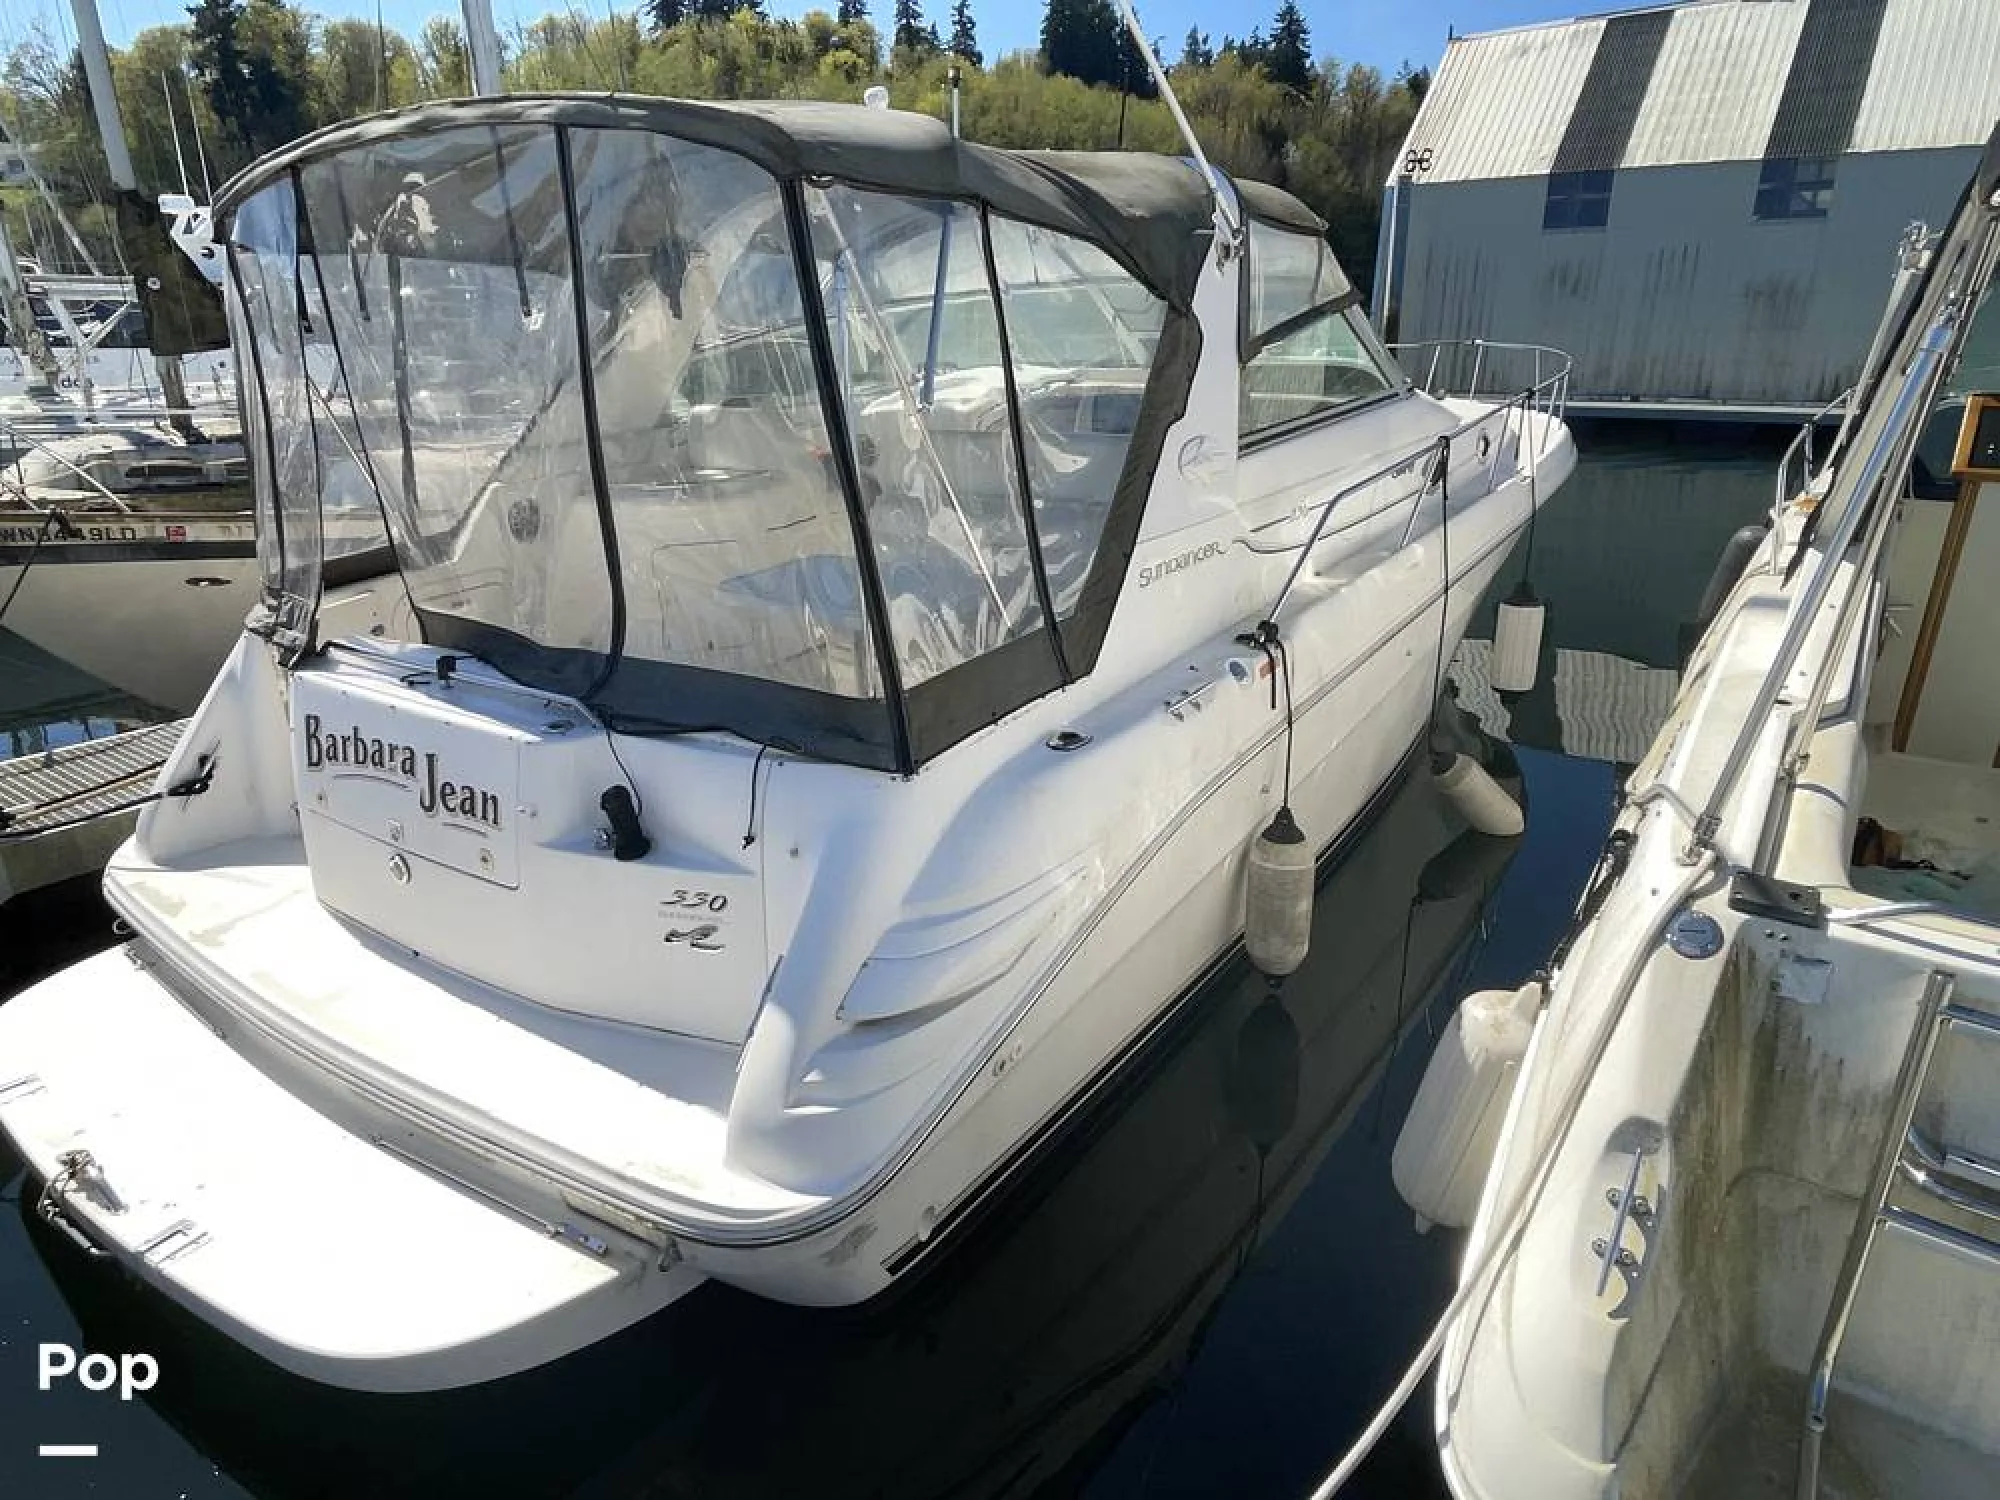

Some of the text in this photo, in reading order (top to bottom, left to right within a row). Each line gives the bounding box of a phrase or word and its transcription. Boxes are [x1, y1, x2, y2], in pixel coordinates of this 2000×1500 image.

[304, 714, 416, 778] Barbara
[419, 752, 499, 826] Jean
[660, 889, 728, 912] 330
